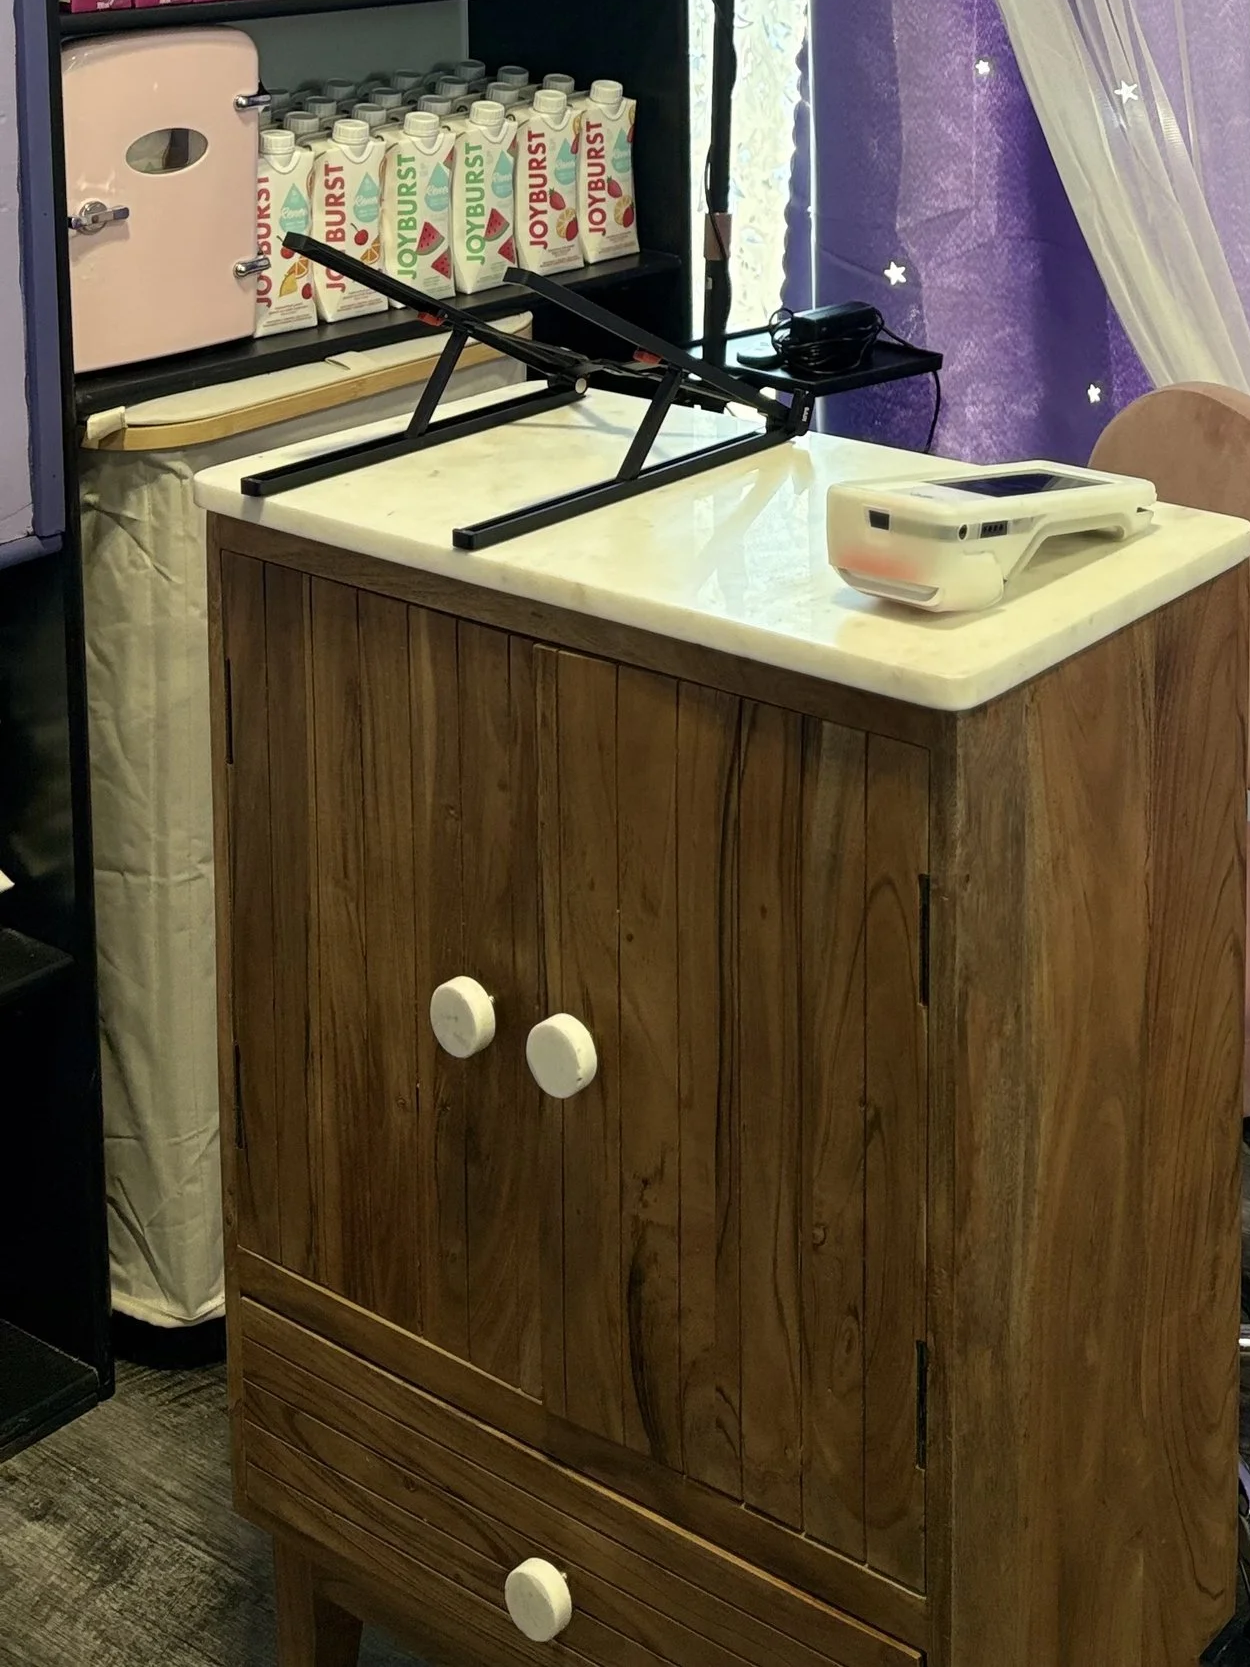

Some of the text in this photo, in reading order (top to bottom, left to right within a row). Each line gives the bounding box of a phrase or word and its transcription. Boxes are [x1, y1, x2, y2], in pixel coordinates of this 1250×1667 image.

[323, 162, 347, 293] JOBURST
[396, 153, 419, 280] JOYBURST
[464, 141, 486, 266] JOYBURST
[527, 129, 549, 251] JOYBURST
[586, 120, 608, 237] JOYBURST
